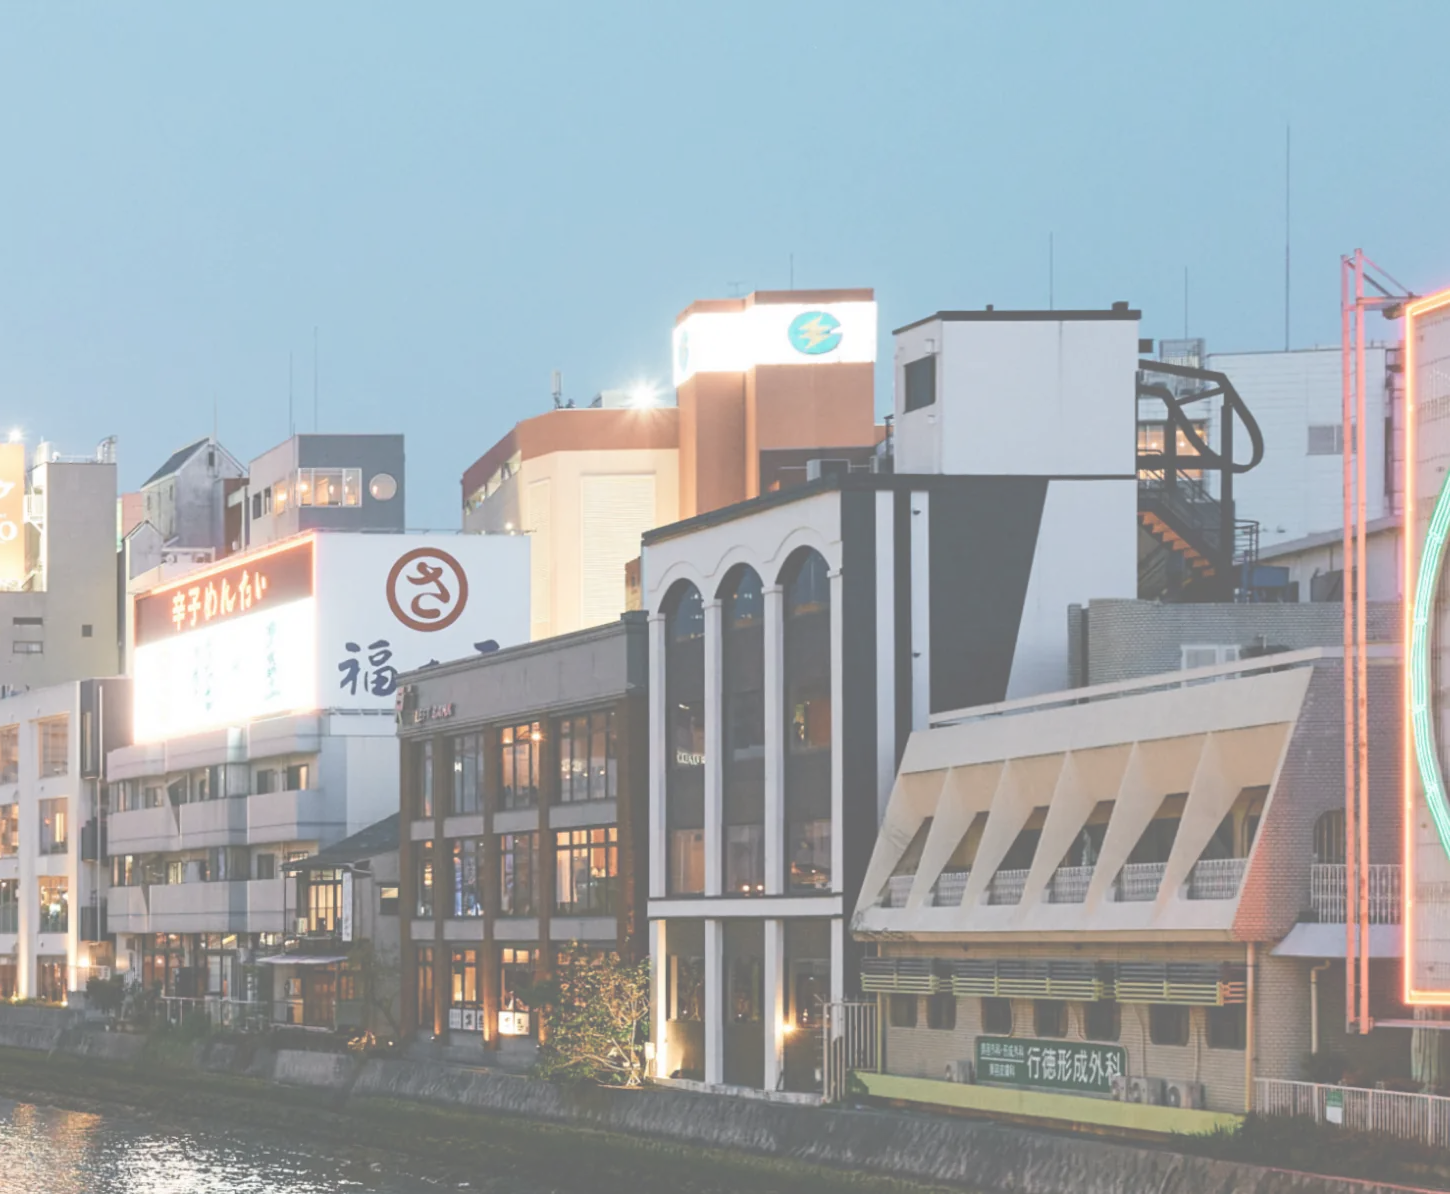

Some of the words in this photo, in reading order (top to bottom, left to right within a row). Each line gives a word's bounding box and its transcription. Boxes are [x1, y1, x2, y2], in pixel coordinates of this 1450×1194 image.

[171, 569, 268, 633] 辛子めんたい
[1027, 1046, 1122, 1087] 行徳形成外科
